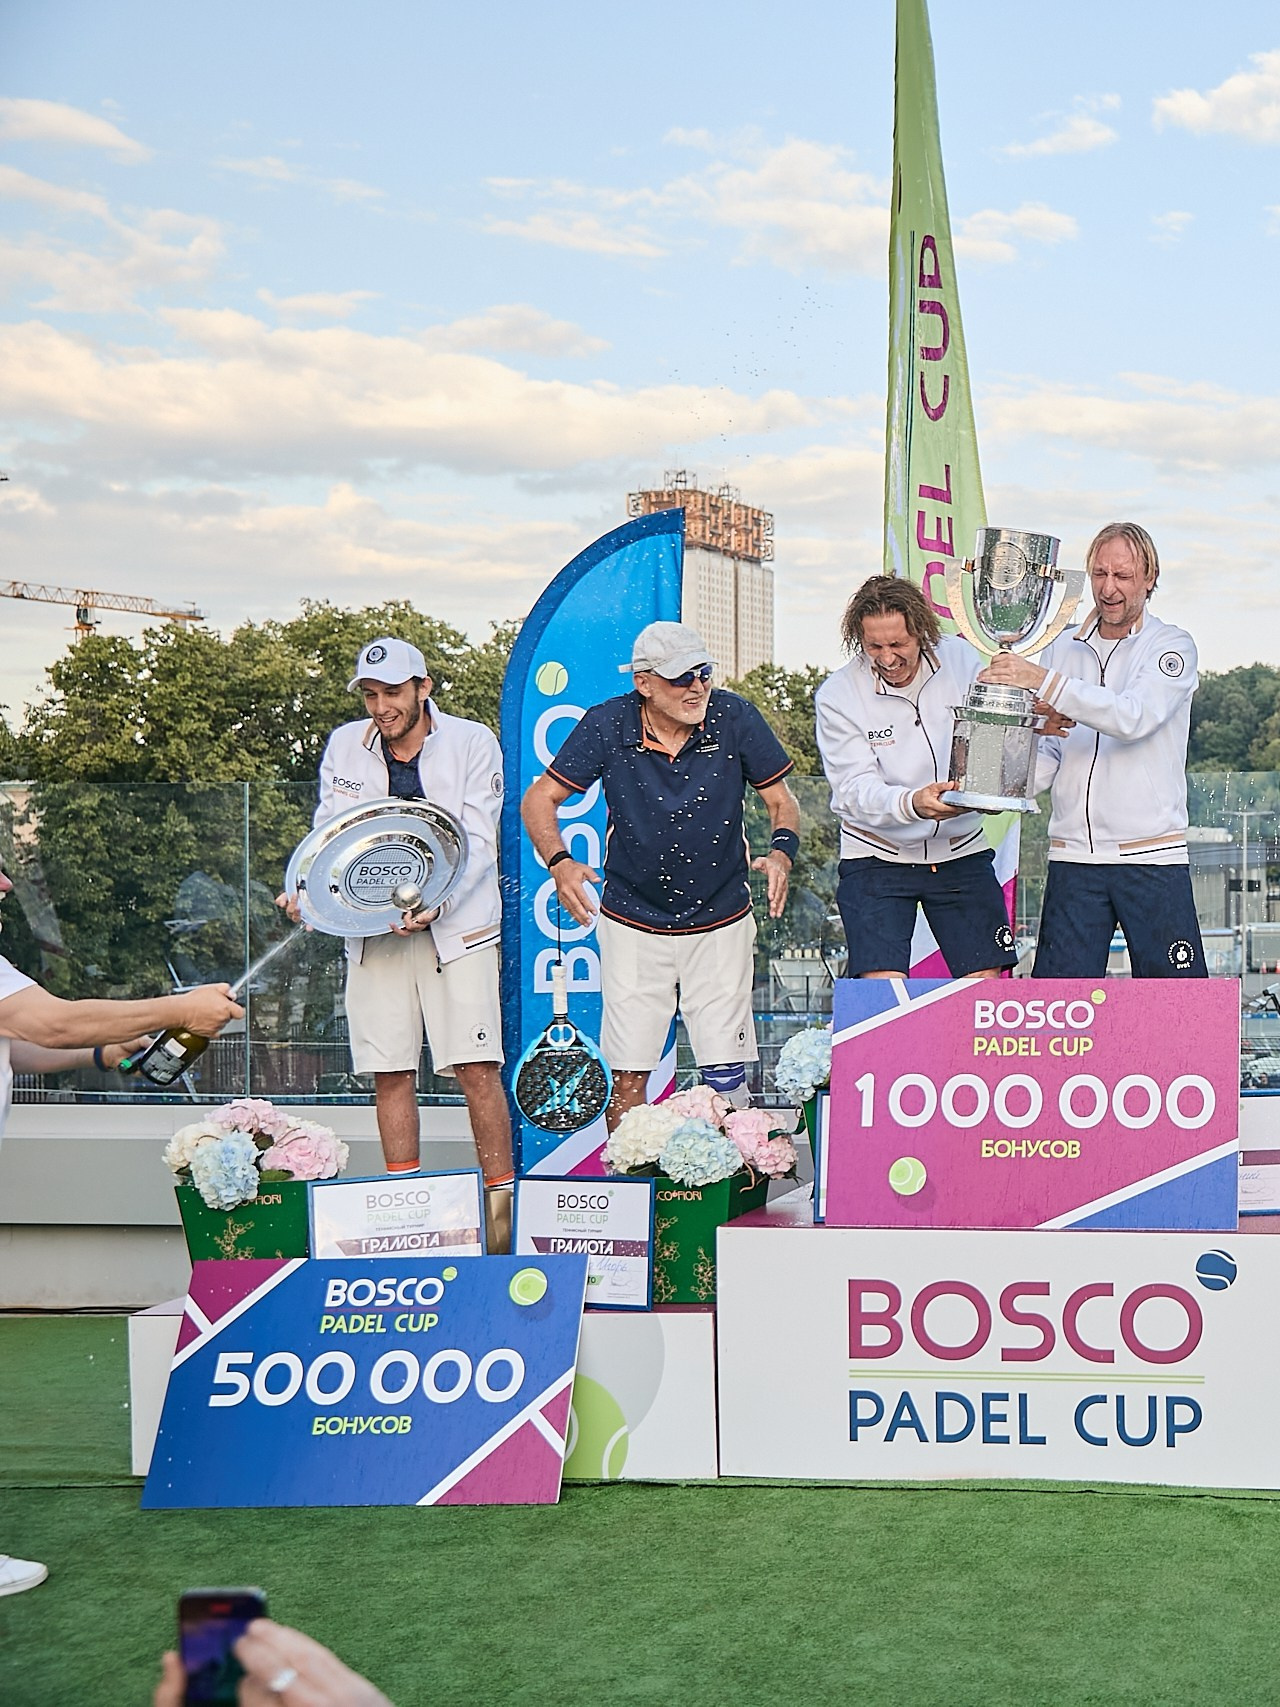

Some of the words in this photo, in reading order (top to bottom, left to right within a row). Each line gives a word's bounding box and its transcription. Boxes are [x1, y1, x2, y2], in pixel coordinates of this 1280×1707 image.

[918, 235, 951, 421] CUP
[916, 464, 957, 622] DEL
[332, 776, 362, 792] BOSCO
[359, 865, 412, 876] BOSCO
[974, 1000, 1095, 1029] BOSCO
[973, 1037, 1041, 1056] PADEL
[1049, 1037, 1093, 1057] CUP
[1058, 1073, 1216, 1130] 000
[981, 1139, 1081, 1159] БОНУСОВ
[366, 1190, 431, 1209] BOSCO
[557, 1194, 609, 1210] BOSCO
[366, 1211, 403, 1223] PADEL
[408, 1208, 431, 1219] CUP
[556, 1213, 587, 1224] PADEL
[589, 1214, 609, 1225] CUP
[361, 1232, 440, 1253] ГРАМОТА
[550, 1238, 614, 1255] ГРАМОТА
[324, 1276, 445, 1308] BOSCO
[319, 1314, 386, 1334] PADEL
[394, 1313, 439, 1333] CUP
[848, 1278, 1204, 1365] BOSCO
[208, 1350, 356, 1408] 500
[370, 1348, 526, 1402] 000
[311, 1415, 412, 1436] БОНУСОВ
[849, 1389, 1047, 1446] PADEL
[1074, 1393, 1203, 1448] CUP
